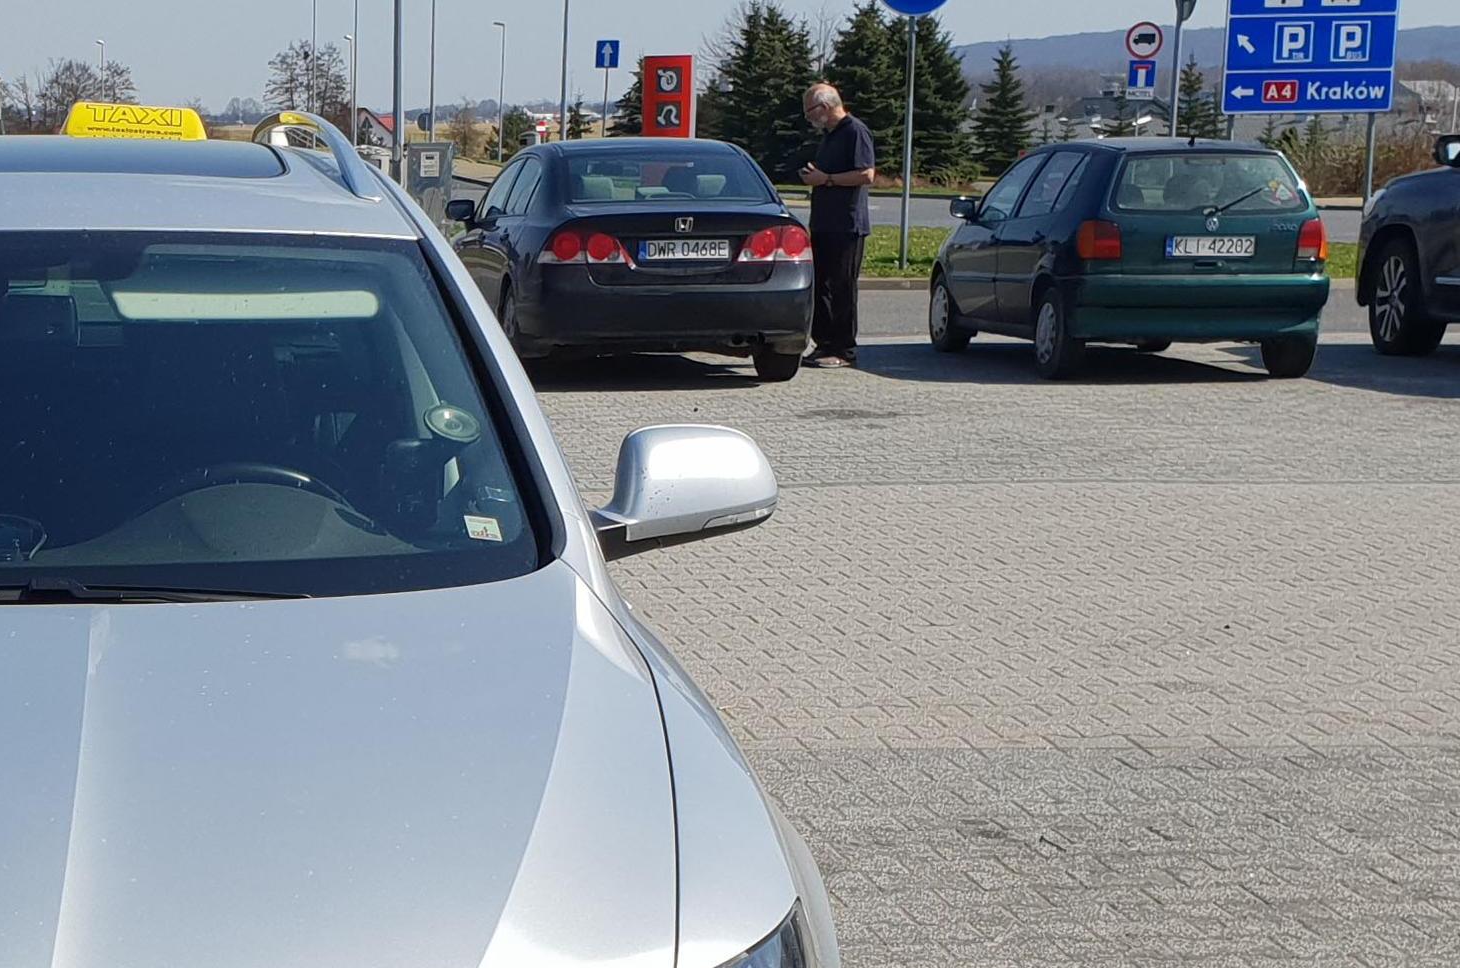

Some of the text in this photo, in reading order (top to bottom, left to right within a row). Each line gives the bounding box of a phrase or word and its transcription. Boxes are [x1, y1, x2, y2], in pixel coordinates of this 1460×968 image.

[1306, 80, 1385, 100] Kraków
[86, 103, 182, 127] TAXI
[647, 242, 727, 257] DWR 0468E
[1174, 238, 1254, 254] KLI 42202
